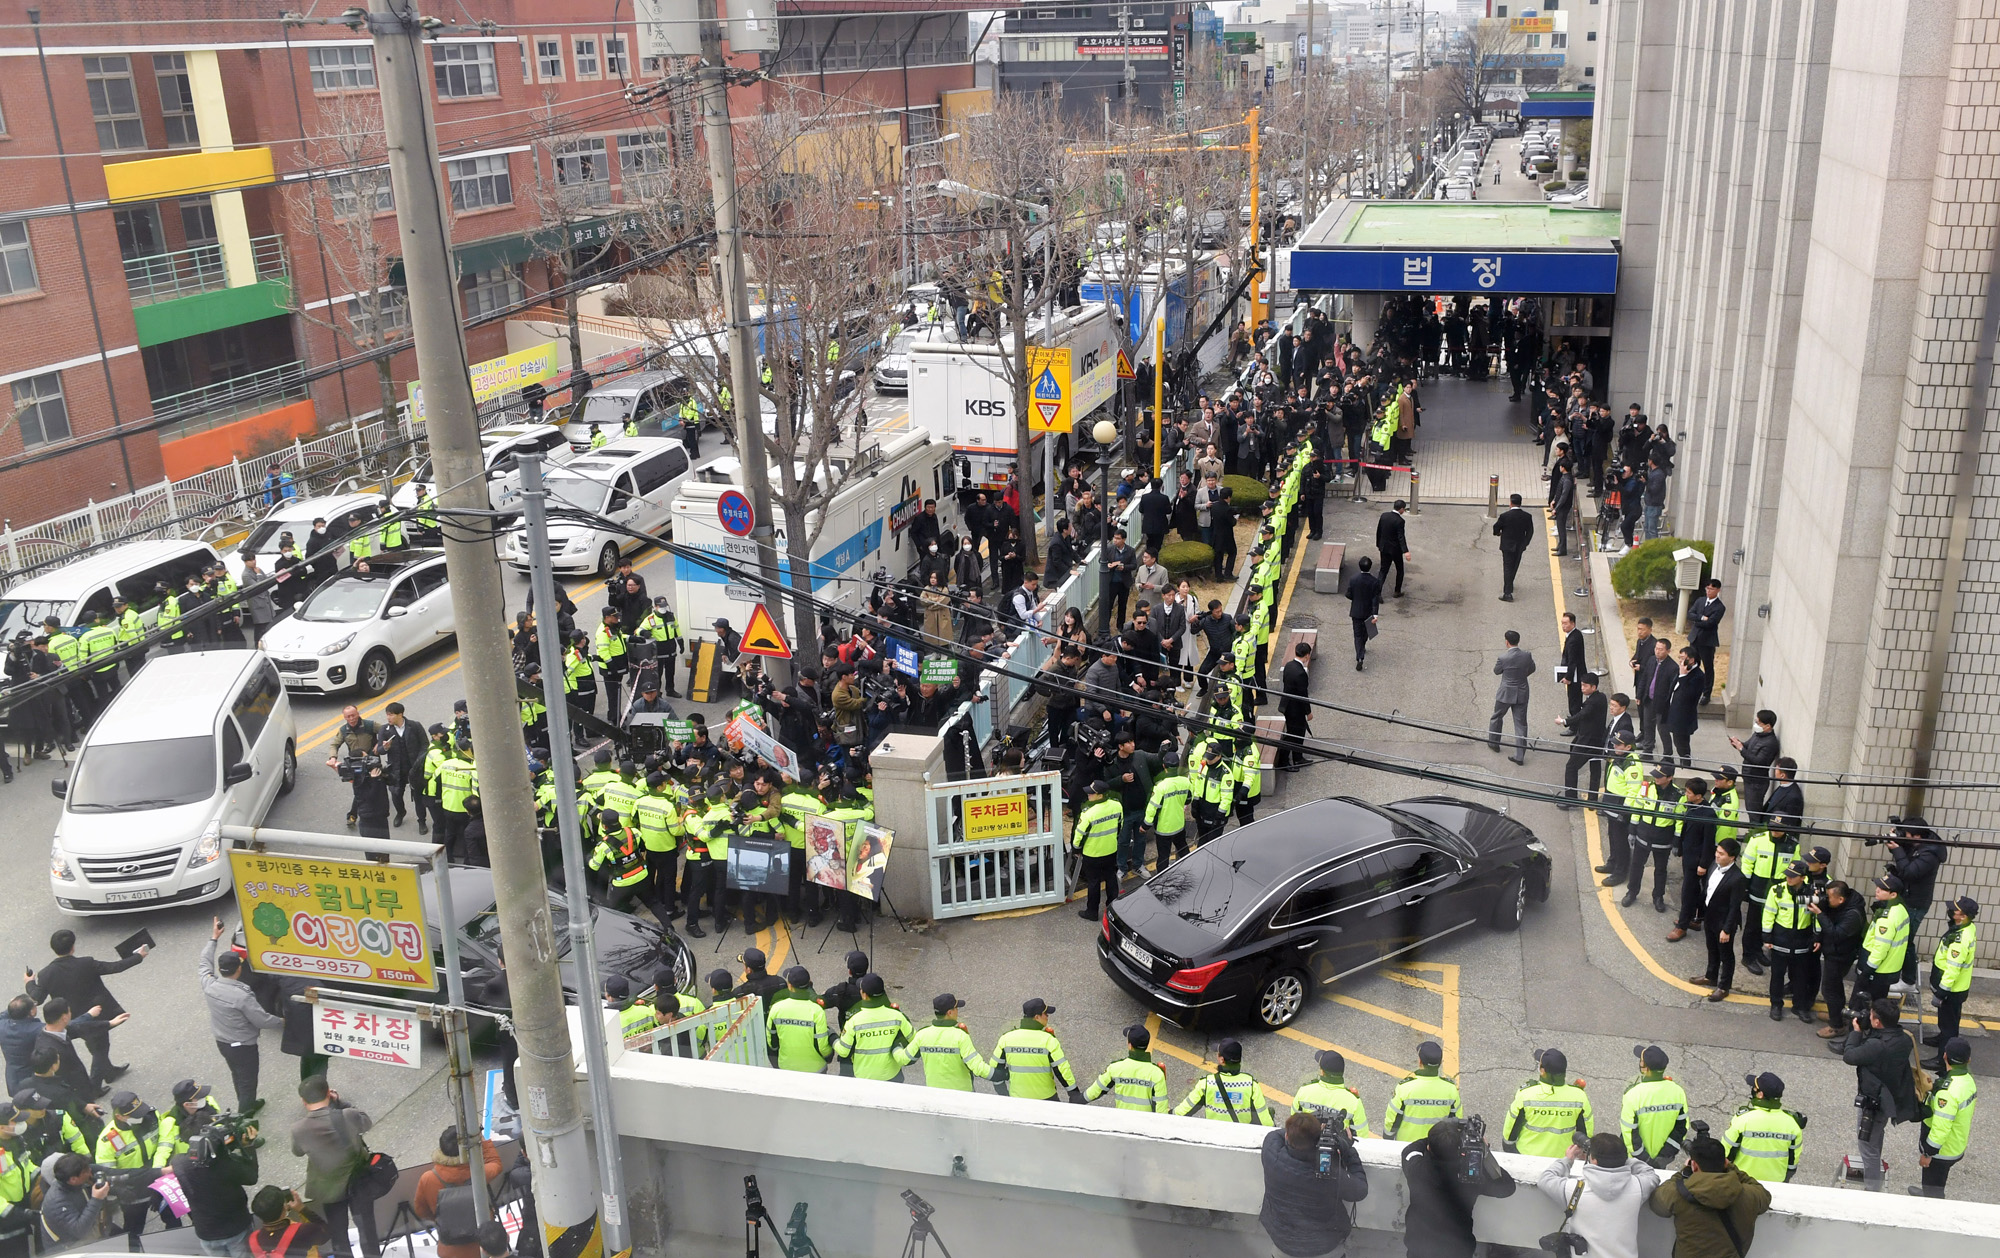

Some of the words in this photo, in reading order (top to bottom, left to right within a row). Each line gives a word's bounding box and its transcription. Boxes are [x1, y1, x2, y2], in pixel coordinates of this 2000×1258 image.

[574, 229, 593, 243] 밝고
[1403, 255, 1502, 289] 법정
[1081, 348, 1099, 377] KBS
[497, 366, 518, 384] CCTV
[519, 355, 548, 378] 단속실시
[966, 399, 1006, 417] KBS
[722, 508, 749, 519] 주정차금지
[892, 500, 919, 528] CHANNEL
[688, 542, 725, 553] CHANNE
[726, 542, 757, 555] 견인지역
[445, 772, 466, 780] POLICE
[608, 795, 634, 805] POLICE
[639, 811, 663, 820] POLICE
[970, 801, 1022, 819] 주차금지
[971, 825, 996, 833] 긴급차량
[256, 860, 303, 875] 평가인증
[309, 865, 332, 878] 우수
[338, 868, 386, 883] 보육시설
[131, 891, 153, 899] 4011
[244, 881, 268, 897] 꿈이
[272, 883, 311, 897] 커가는
[314, 883, 402, 917] 꿈나무
[292, 911, 424, 963] 어린이집
[270, 954, 360, 976] 228-9957
[381, 969, 416, 982] 150m
[321, 1008, 413, 1040] 주차장
[780, 1018, 812, 1027] POLICE
[859, 1028, 895, 1038] POLICE
[324, 1031, 342, 1041] 법원
[347, 1035, 366, 1044] 후문
[371, 1038, 410, 1051] 있습니다
[923, 1046, 955, 1054] POLICE
[360, 1051, 394, 1062] 100m
[1119, 1077, 1150, 1087] POLICE
[1533, 1109, 1573, 1117] POLICE
[1644, 1103, 1678, 1113] POLICE
[1751, 1131, 1789, 1139] POLICE
